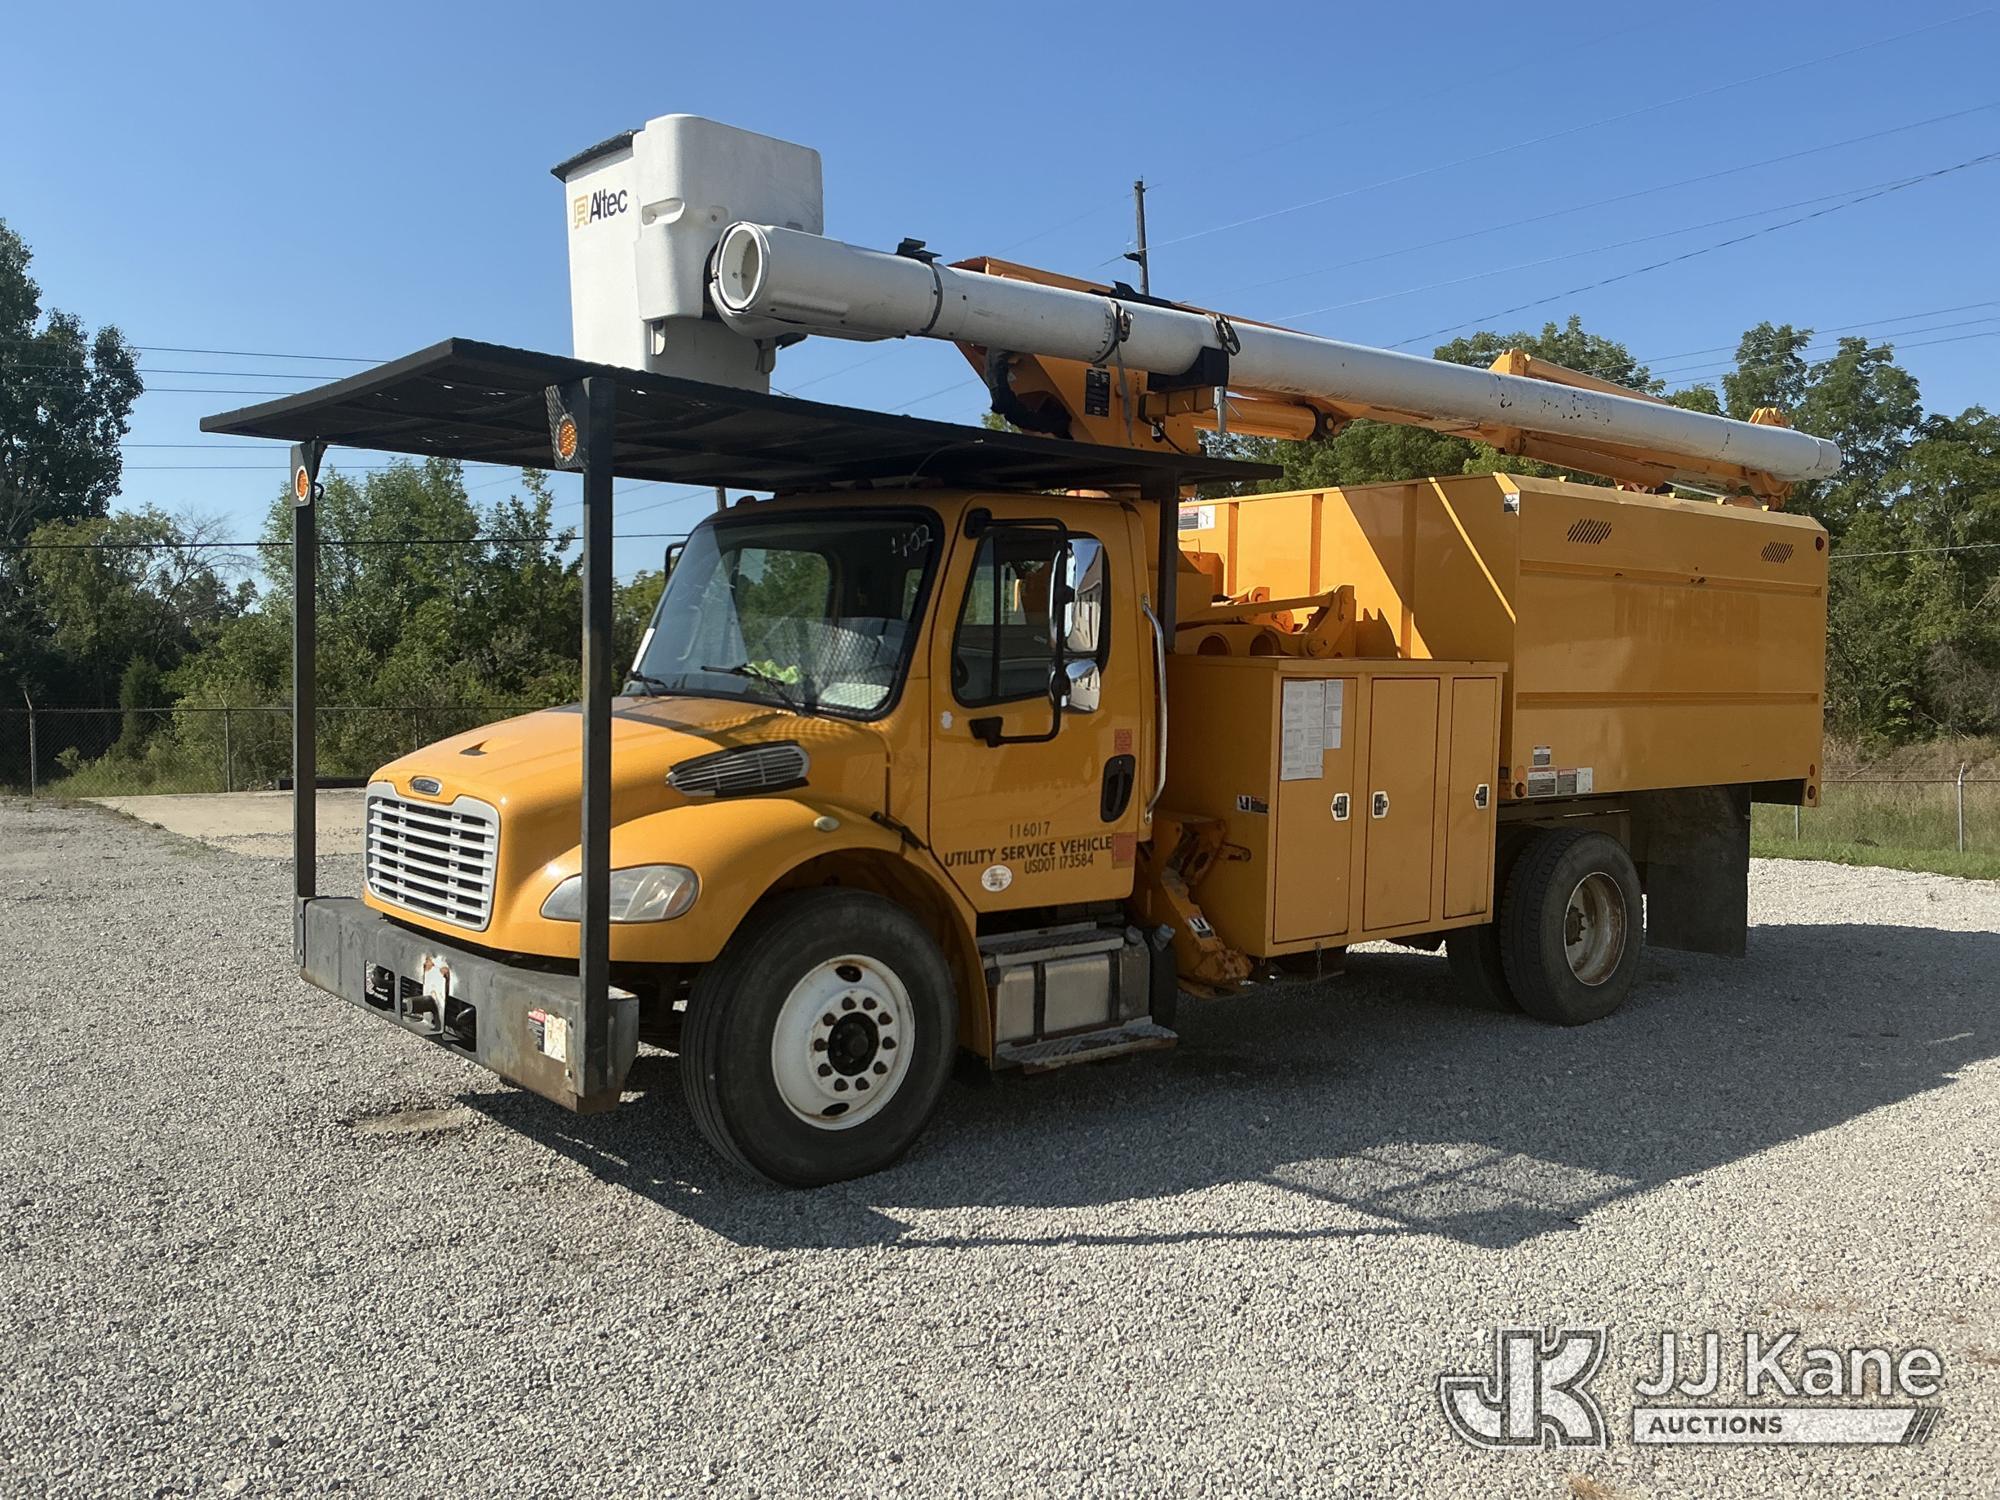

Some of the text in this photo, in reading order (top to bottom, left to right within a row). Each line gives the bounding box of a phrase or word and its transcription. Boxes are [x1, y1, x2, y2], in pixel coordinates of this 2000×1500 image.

[590, 188, 628, 224] Altec
[1009, 821, 1051, 839] 116017
[944, 848, 997, 868] UTILITY
[1001, 842, 1056, 861] SERVICE
[1060, 835, 1113, 854] VEHICLE
[1024, 853, 1094, 874] USDOT 173584
